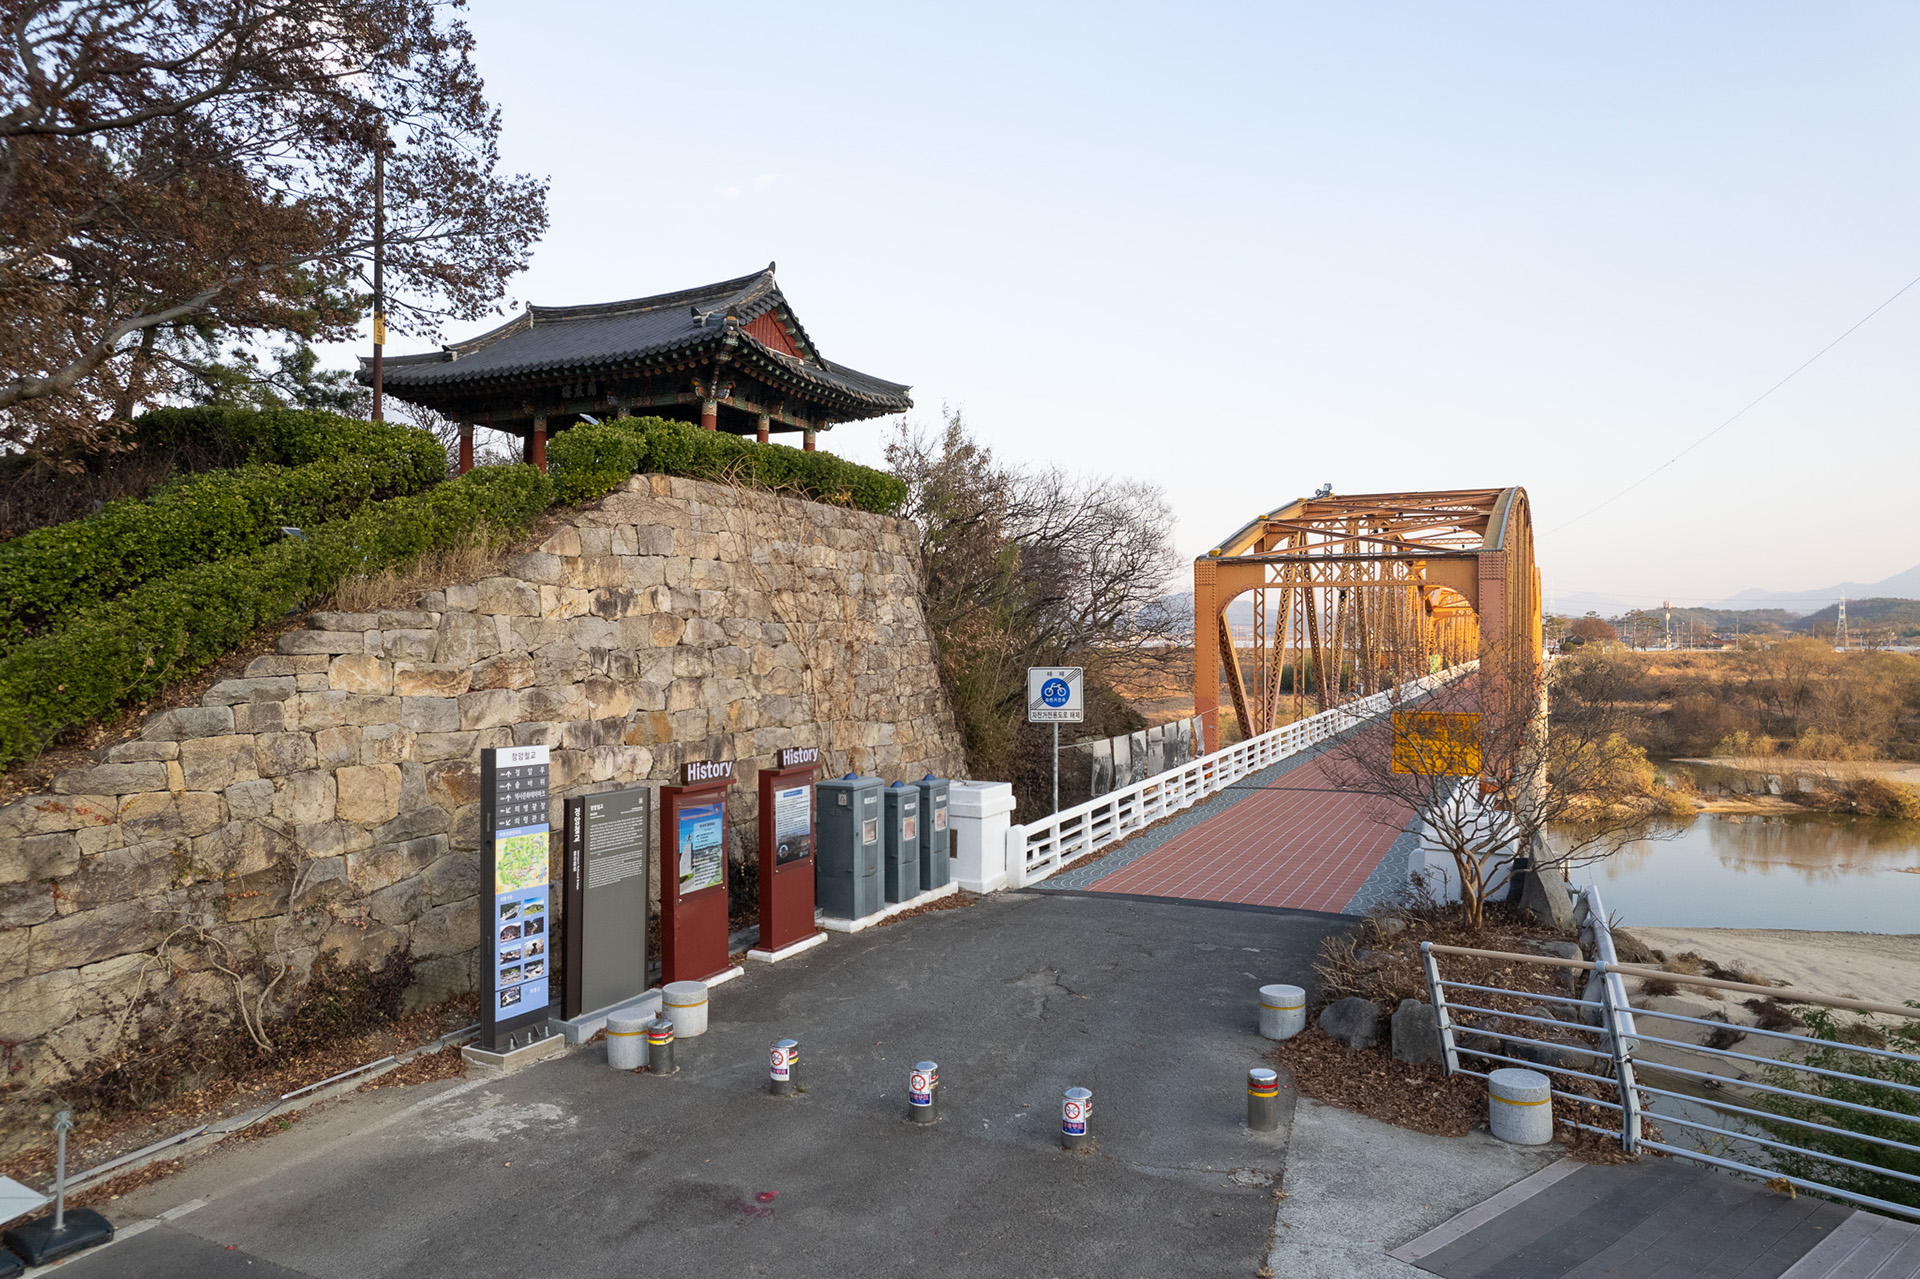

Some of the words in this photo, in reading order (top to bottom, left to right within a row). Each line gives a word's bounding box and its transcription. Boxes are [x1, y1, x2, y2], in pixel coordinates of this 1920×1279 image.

[512, 751, 536, 761] 정암철교
[782, 747, 819, 766] History
[687, 761, 733, 782] History
